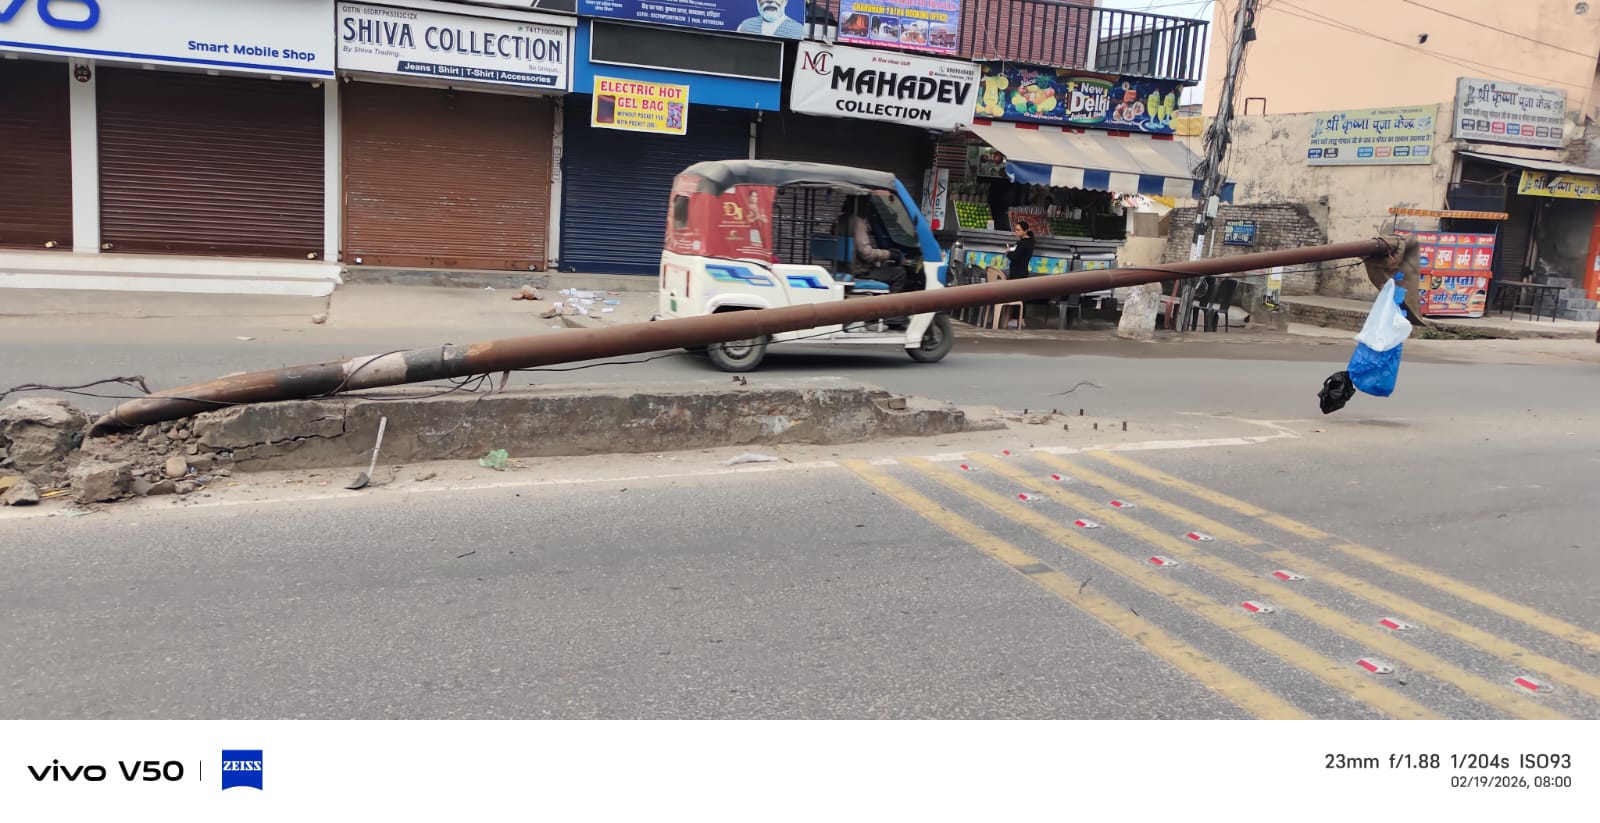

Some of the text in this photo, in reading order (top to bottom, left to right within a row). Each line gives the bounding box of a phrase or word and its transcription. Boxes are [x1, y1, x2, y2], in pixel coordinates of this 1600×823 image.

[343, 17, 562, 64] SHIVA COLLECTION
[188, 40, 316, 63] Smart Mobile Shop
[404, 62, 551, 83] Jeans Shirt T-Shirt Accessories
[601, 81, 682, 99] ELECTRIC HOT
[831, 65, 972, 106] MAHADEV
[1080, 82, 1103, 94] New
[617, 97, 664, 111] GEL BAG
[1071, 91, 1111, 112] Delhi
[1478, 84, 1489, 103] श्री
[1519, 97, 1534, 111] पूजा
[637, 112, 654, 120] POCKET
[836, 99, 932, 121] COLLECTION
[1326, 114, 1339, 131] श्री
[1342, 119, 1369, 134] कृष्णा
[1372, 119, 1391, 134] पूजा
[1444, 276, 1475, 290] गुप्ता
